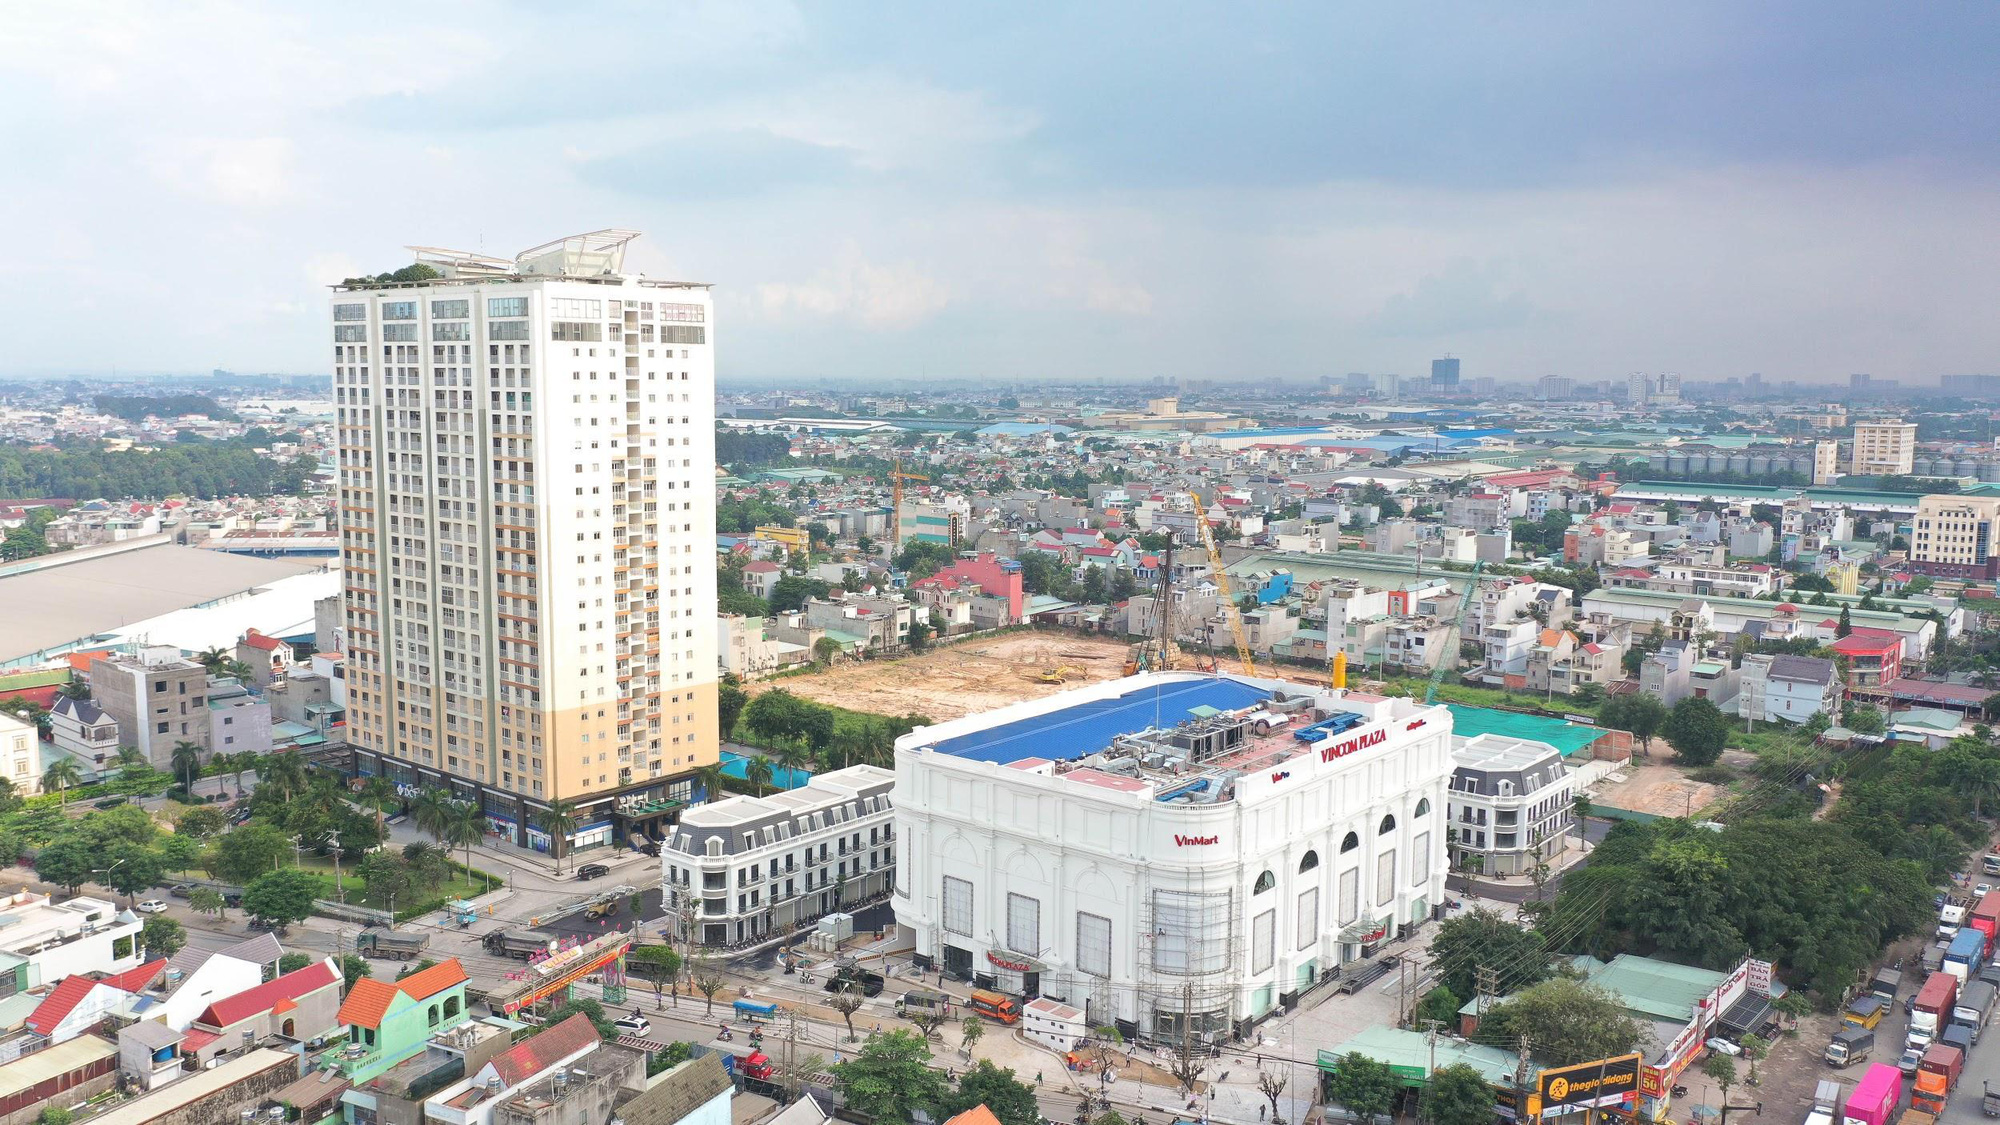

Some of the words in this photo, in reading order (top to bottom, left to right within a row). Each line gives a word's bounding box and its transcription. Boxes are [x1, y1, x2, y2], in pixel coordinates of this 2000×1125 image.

[1321, 739, 1358, 764] VINCOM
[1358, 729, 1387, 749] PLAZA
[1174, 834, 1219, 847] VinMart
[1569, 1072, 1633, 1092] thegiodidong
